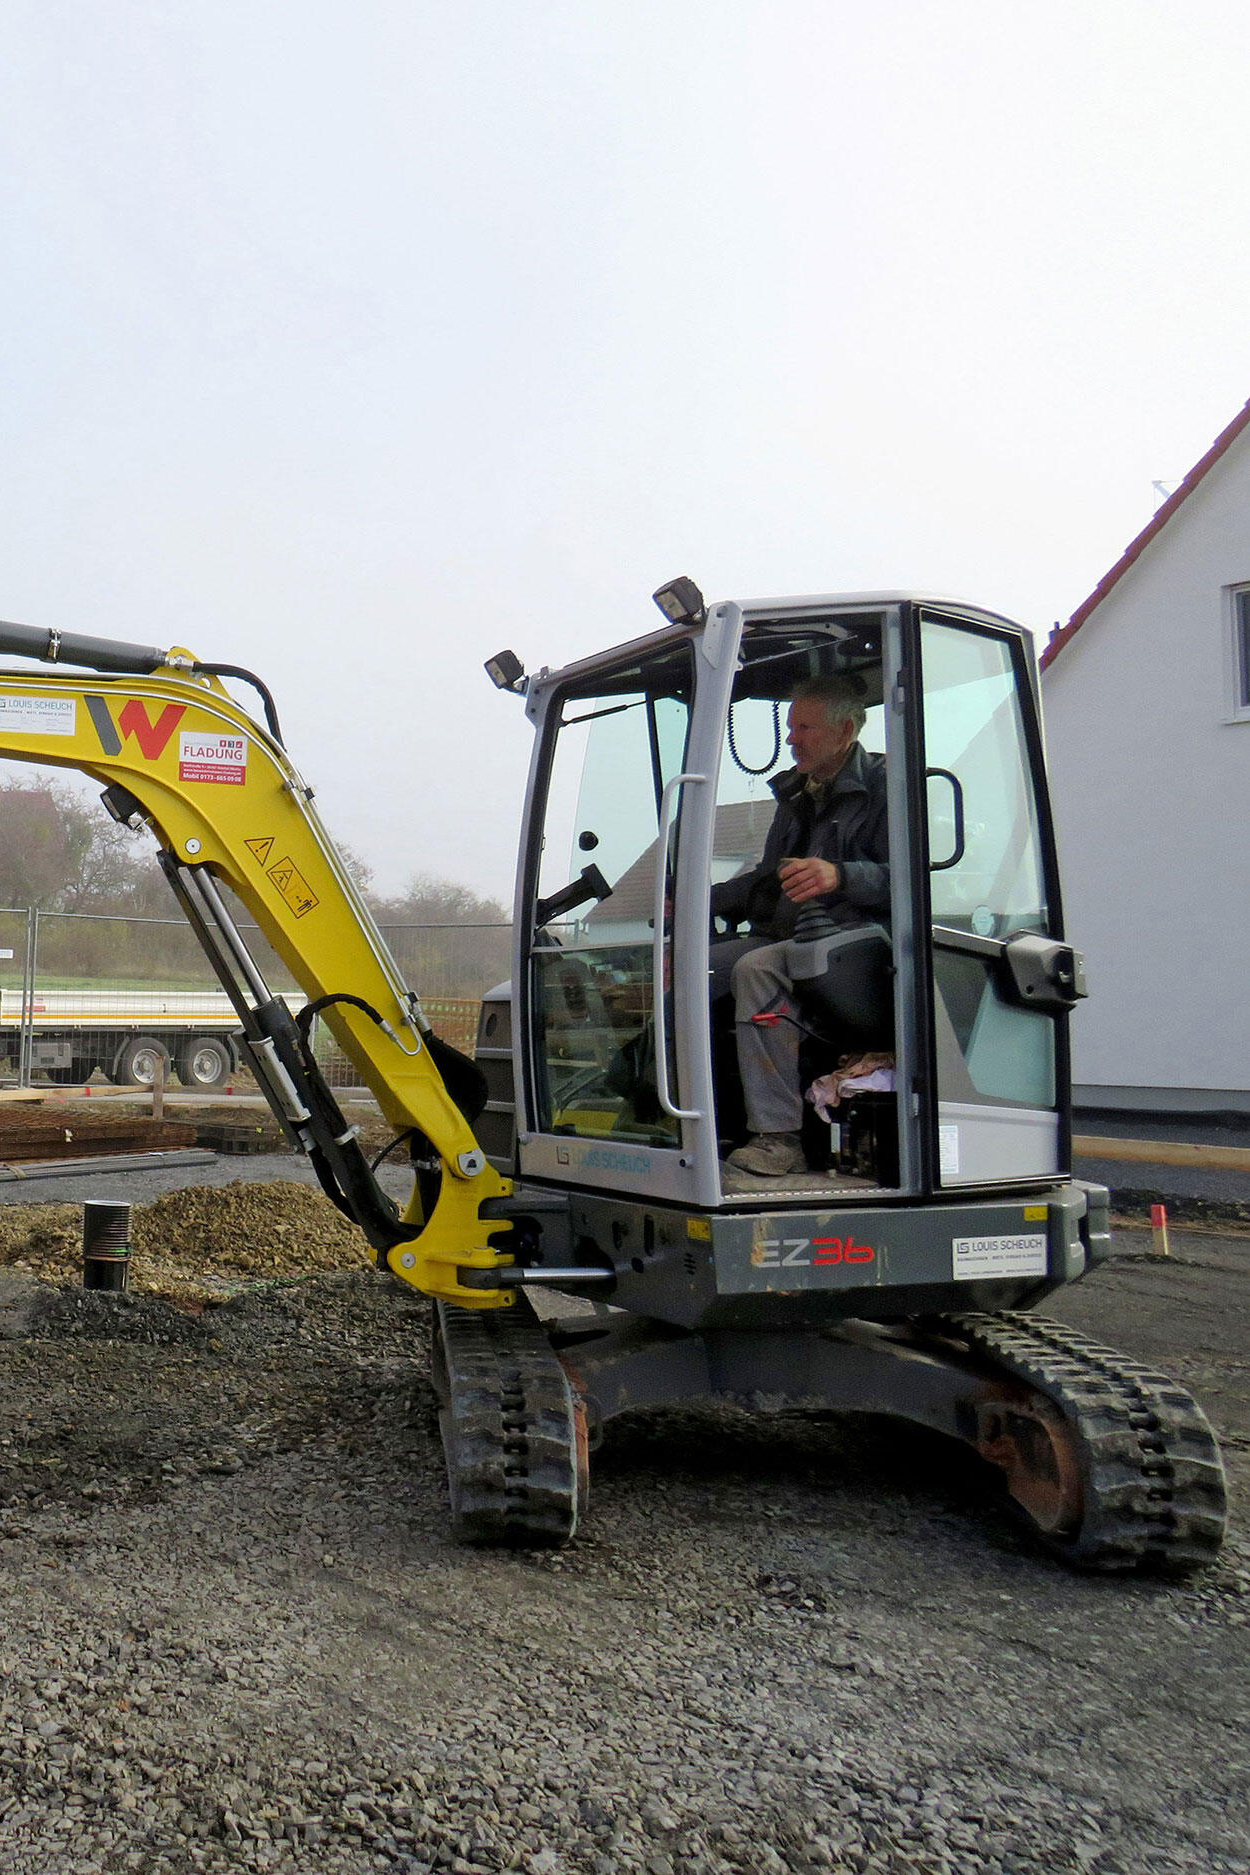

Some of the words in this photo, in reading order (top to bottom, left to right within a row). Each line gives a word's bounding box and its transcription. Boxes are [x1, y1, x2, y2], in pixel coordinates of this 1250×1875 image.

[8, 699, 32, 709] LOUIS
[34, 701, 73, 711] SCHEUCH
[183, 745, 243, 761] FLADUNG
[751, 1236, 876, 1268] EZ36
[972, 1240, 998, 1252] LOUIS
[999, 1238, 1043, 1250] SCHEUCH
